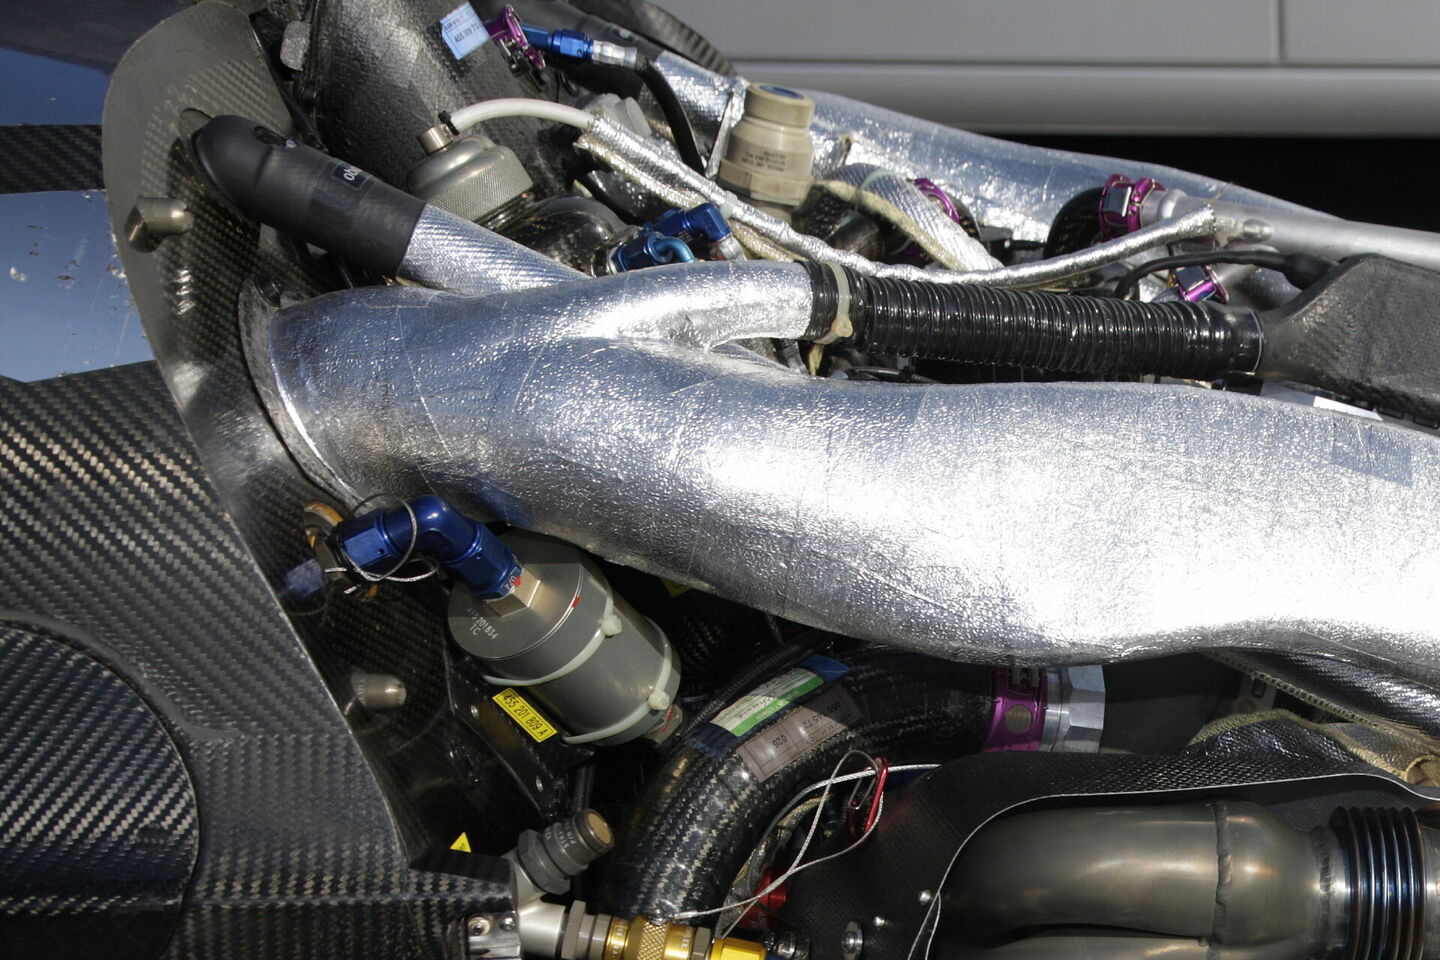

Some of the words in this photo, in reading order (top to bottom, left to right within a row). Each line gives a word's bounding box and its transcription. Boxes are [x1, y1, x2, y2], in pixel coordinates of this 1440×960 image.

[469, 624, 481, 636] TC
[503, 694, 519, 708] 455
[514, 705, 531, 719] 201
[526, 716, 543, 731] 809
